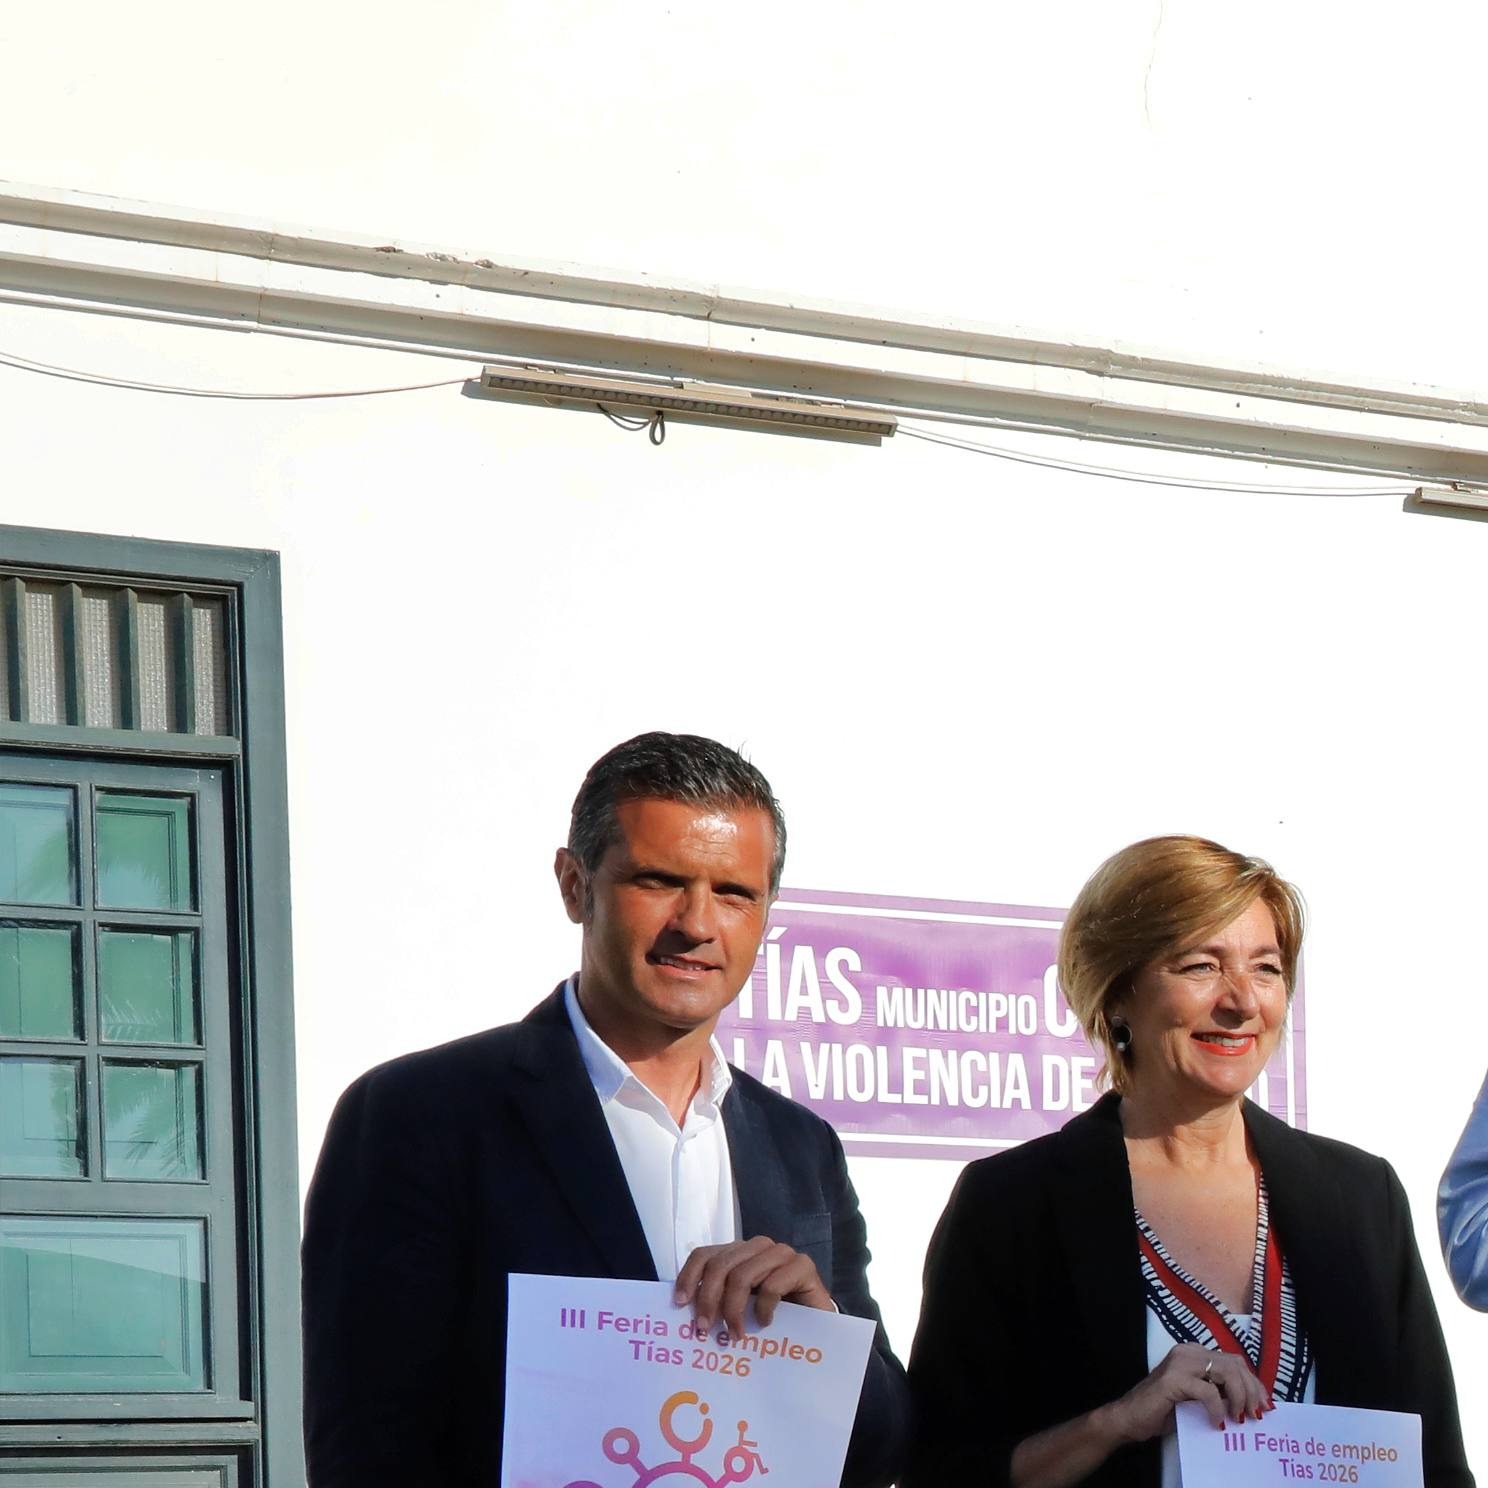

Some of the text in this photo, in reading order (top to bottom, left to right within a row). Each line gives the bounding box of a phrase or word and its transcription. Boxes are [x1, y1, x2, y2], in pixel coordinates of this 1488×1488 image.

[876, 986, 1038, 1036] MUNICIPIO
[800, 1041, 1032, 1110] VIOLENCIA
[1042, 1054, 1096, 1112] DE
[560, 1308, 823, 1364] III Feria de empleo
[628, 1339, 751, 1377] Tías 2026
[1224, 1433, 1398, 1464] III Feria de empleo
[1318, 1462, 1359, 1483] 2026
